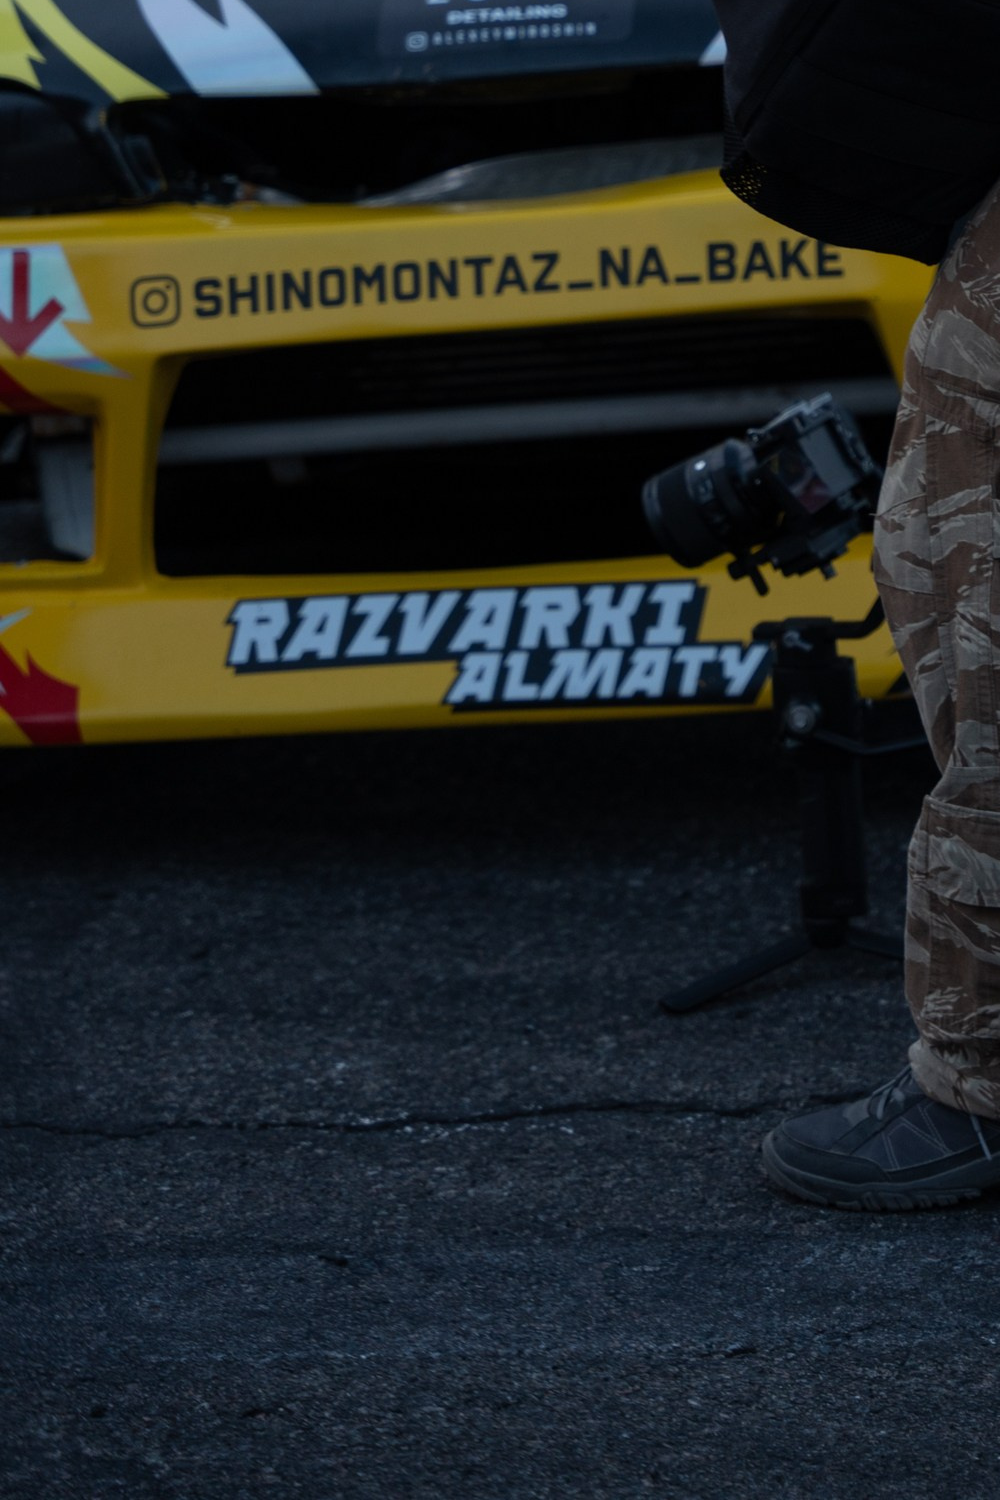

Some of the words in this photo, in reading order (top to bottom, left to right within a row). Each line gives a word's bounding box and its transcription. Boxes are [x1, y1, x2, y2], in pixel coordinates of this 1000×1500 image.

[446, 4, 567, 25] DETAILING
[195, 240, 844, 318] SHINOMONTAZ_NA_BAKE
[228, 582, 697, 665] RAZVARKI
[446, 645, 769, 704] ALMATY
